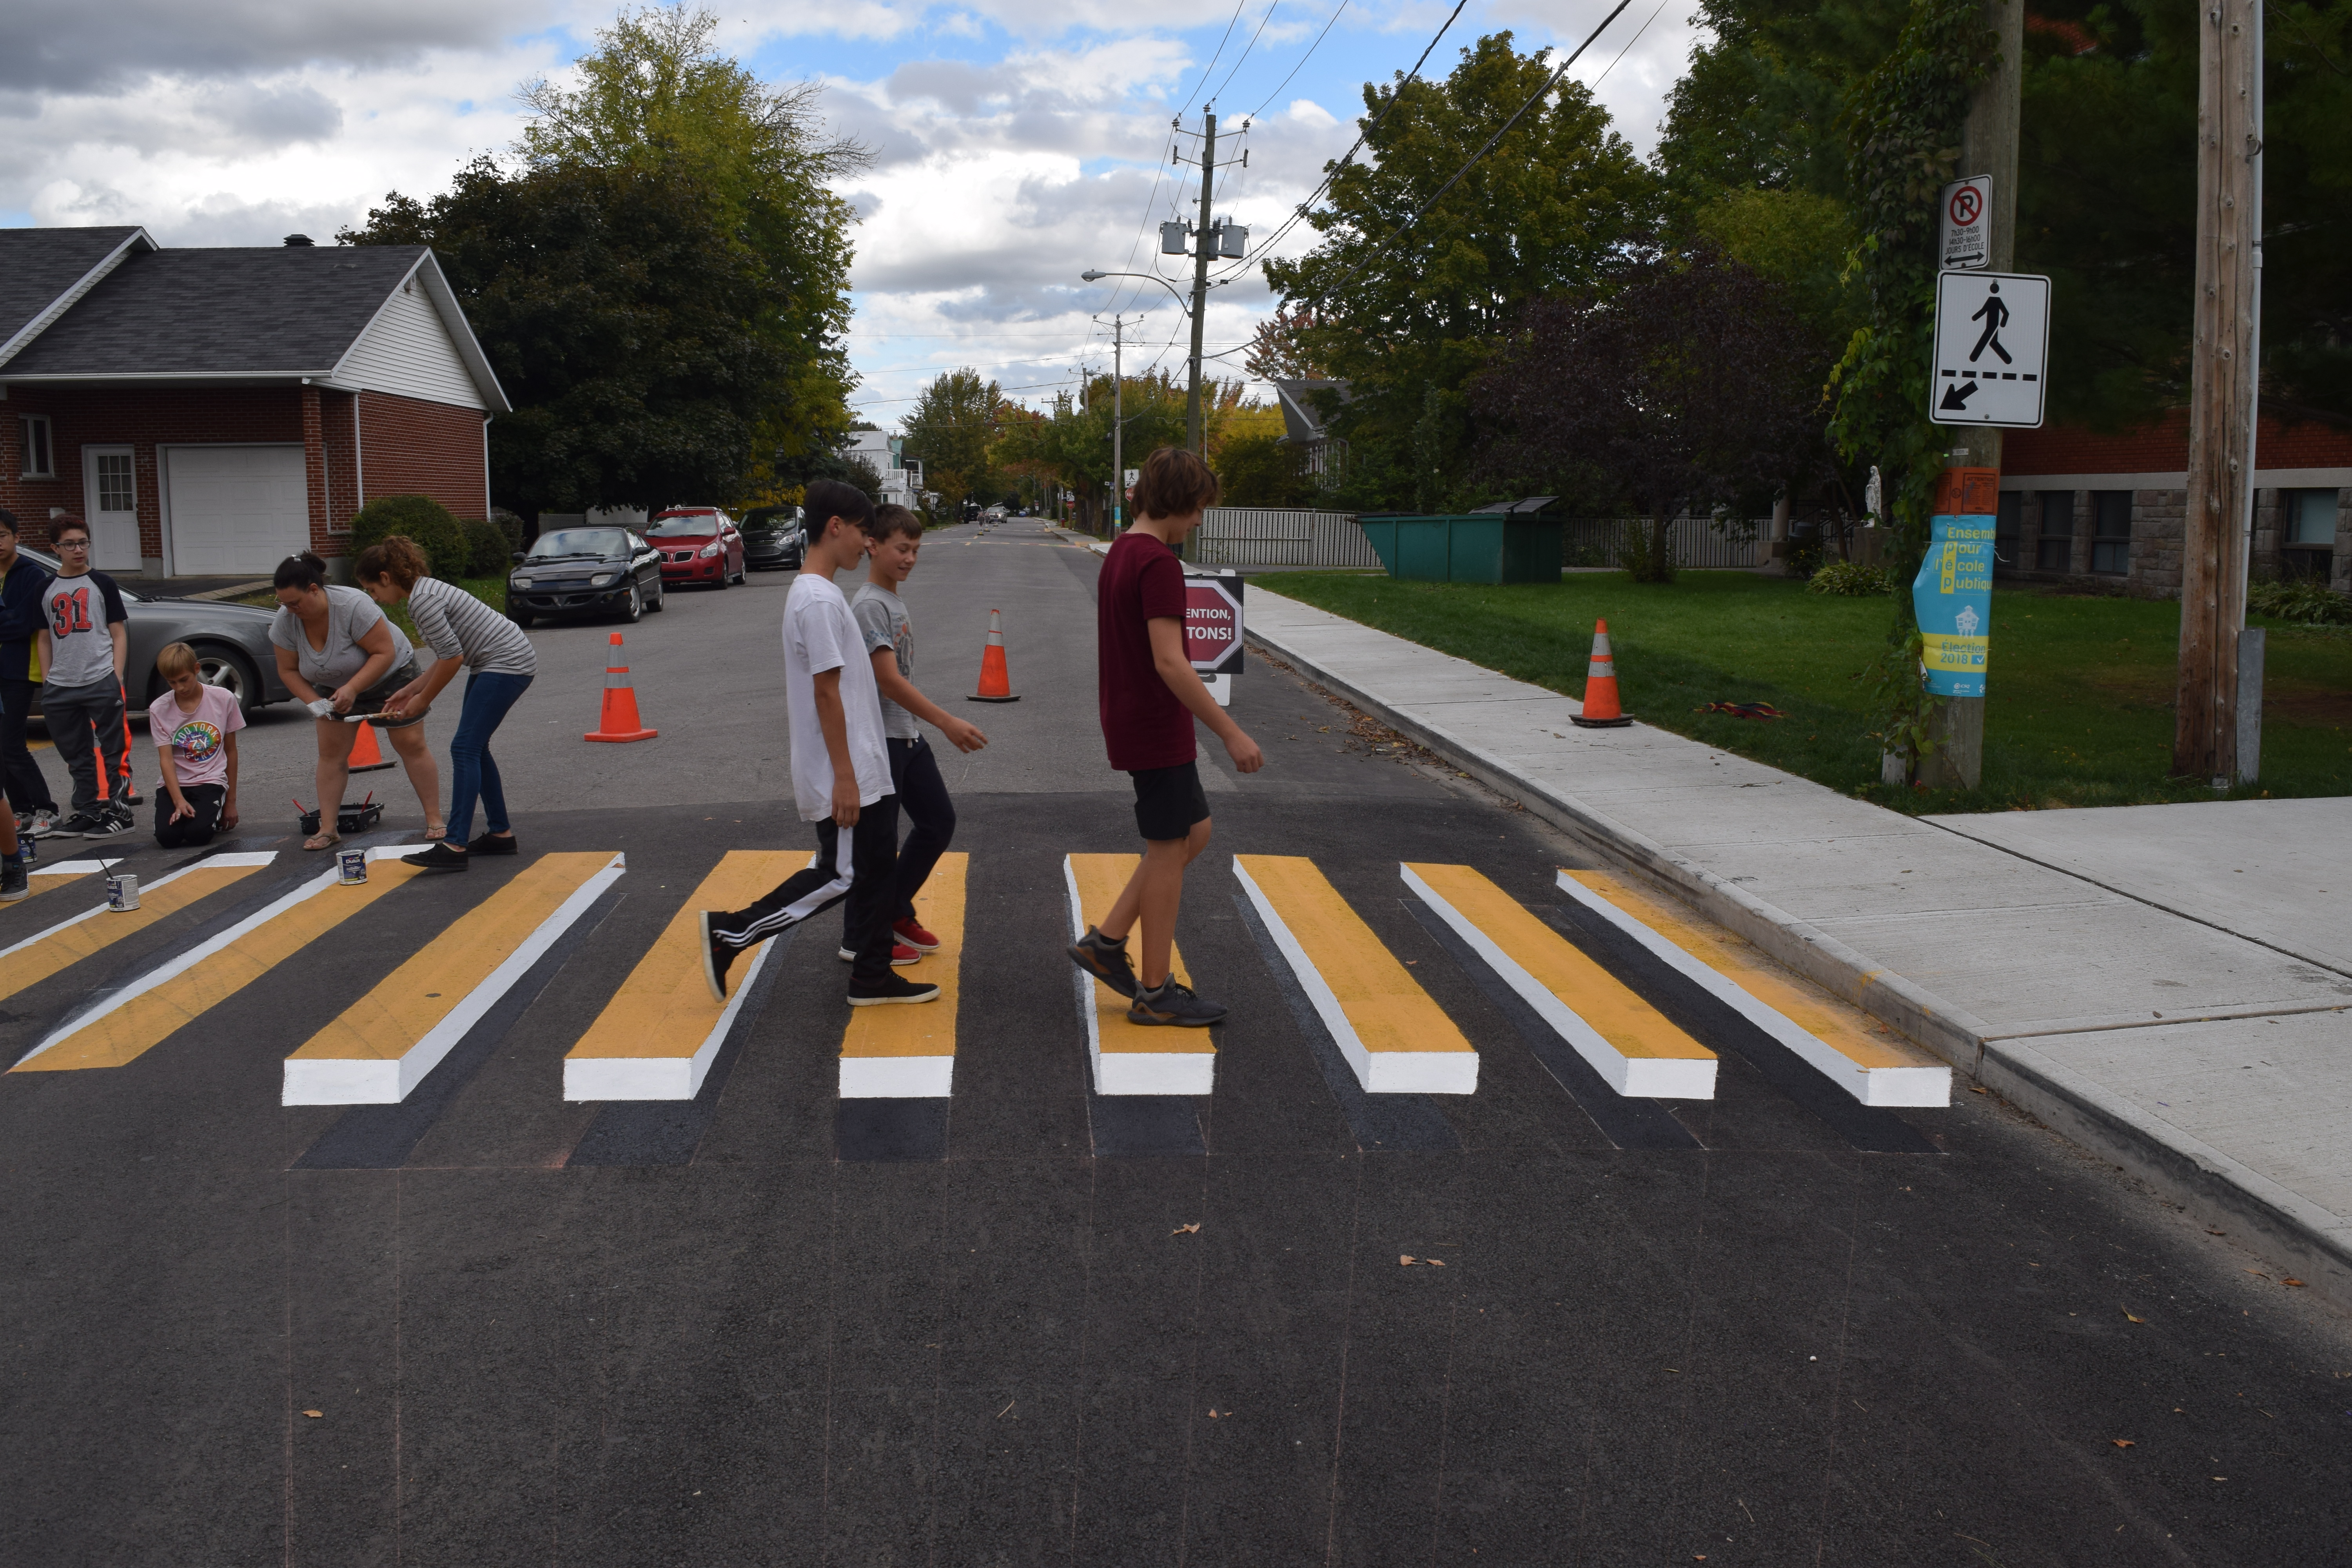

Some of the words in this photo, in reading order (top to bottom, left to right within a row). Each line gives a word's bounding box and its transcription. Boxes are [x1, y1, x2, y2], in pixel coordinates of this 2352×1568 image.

[1951, 226, 1979, 237] 7h30-9h00
[1949, 234, 1980, 246] 14h30-16h00
[1945, 245, 1962, 255] JOURS
[1963, 242, 1985, 252] D'ÉCOLE
[52, 587, 93, 639] 31
[1186, 626, 1232, 640] TONS!
[1941, 639, 1986, 653] Élection
[1940, 653, 1968, 664] 2018
[176, 727, 191, 744] ZOO
[193, 723, 219, 738] YORK
[194, 743, 218, 761] CREW
